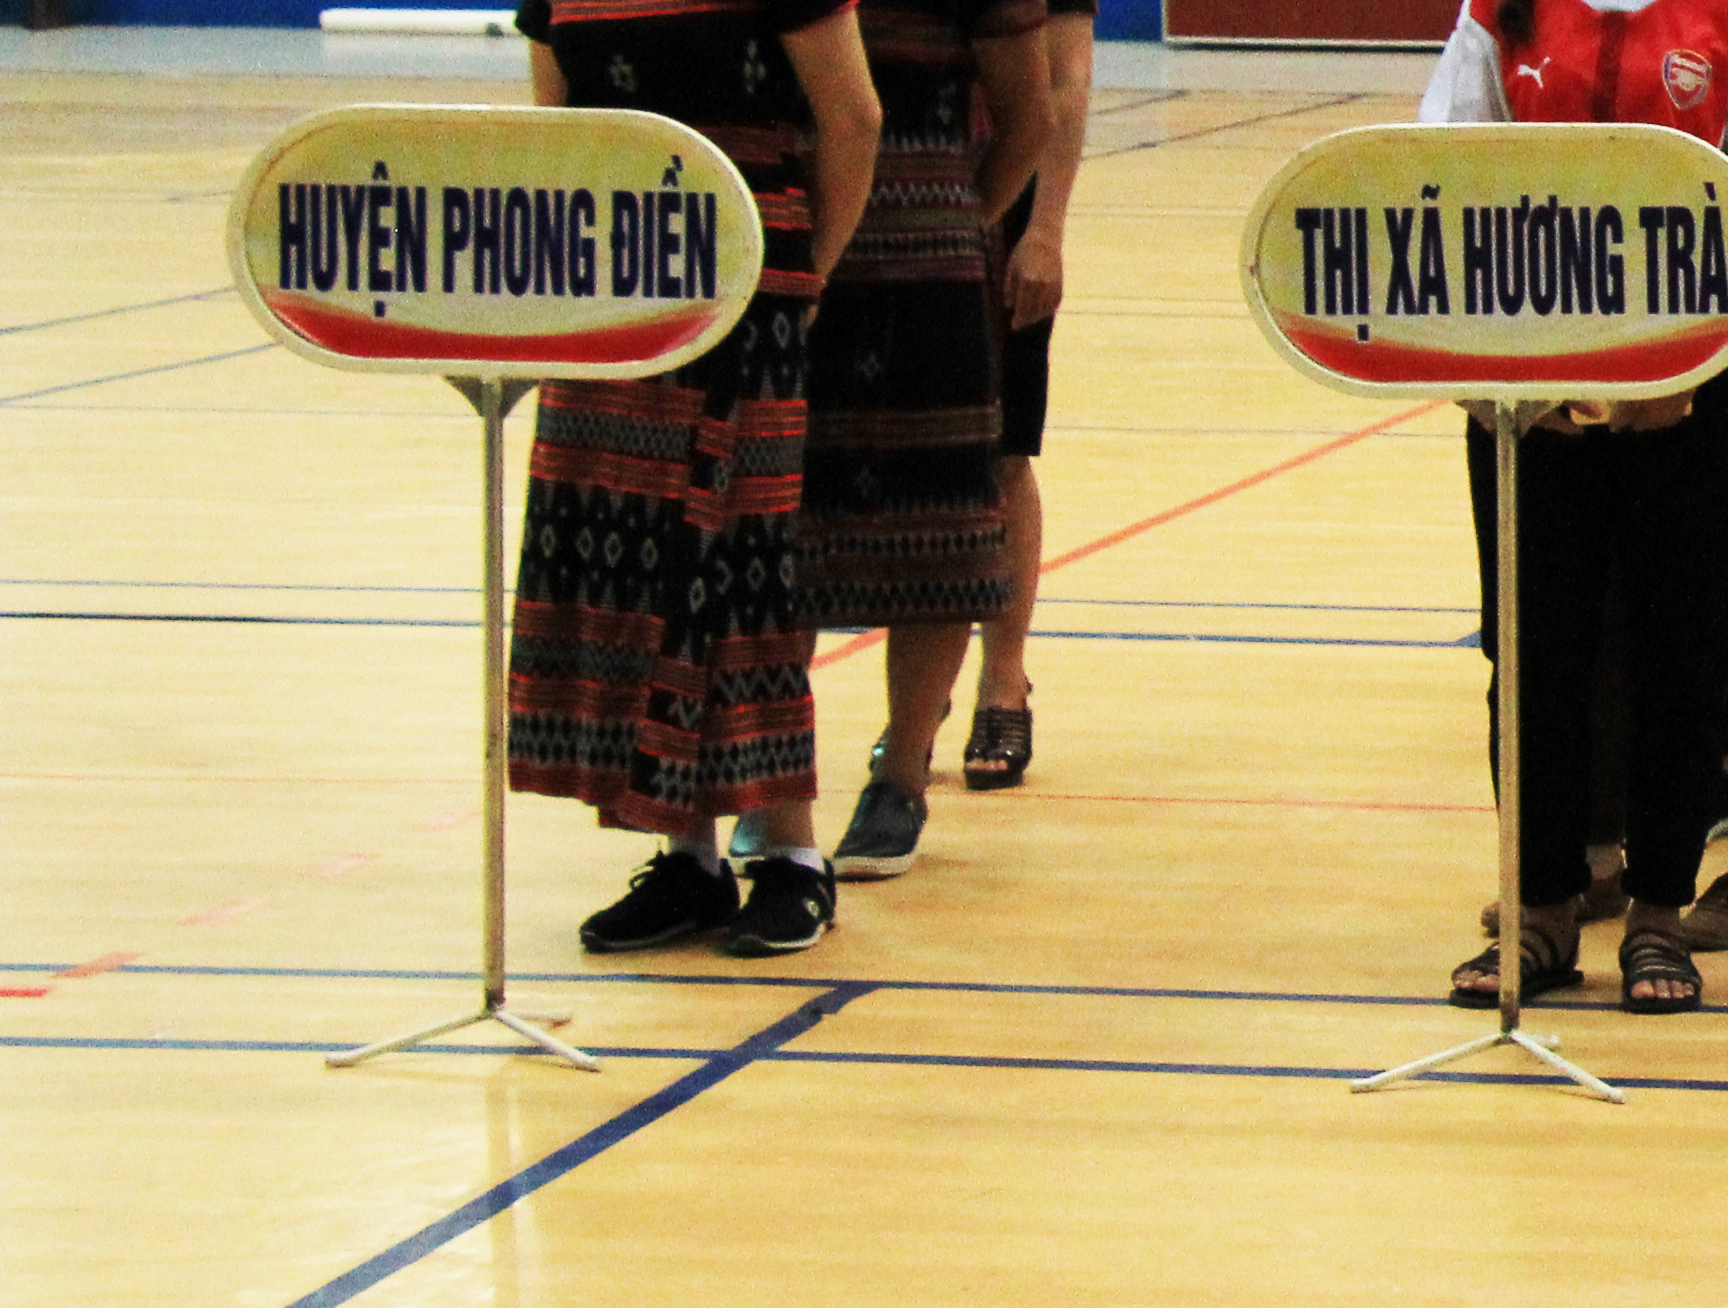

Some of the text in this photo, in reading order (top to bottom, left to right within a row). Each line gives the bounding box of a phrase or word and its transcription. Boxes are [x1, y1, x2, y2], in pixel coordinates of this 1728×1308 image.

[279, 156, 716, 317] HUYỆN PHONG ĐIỀN
[1296, 208, 1369, 340] THỊ
[1385, 185, 1449, 314] XÃ
[1463, 196, 1624, 315] HƯƠNG
